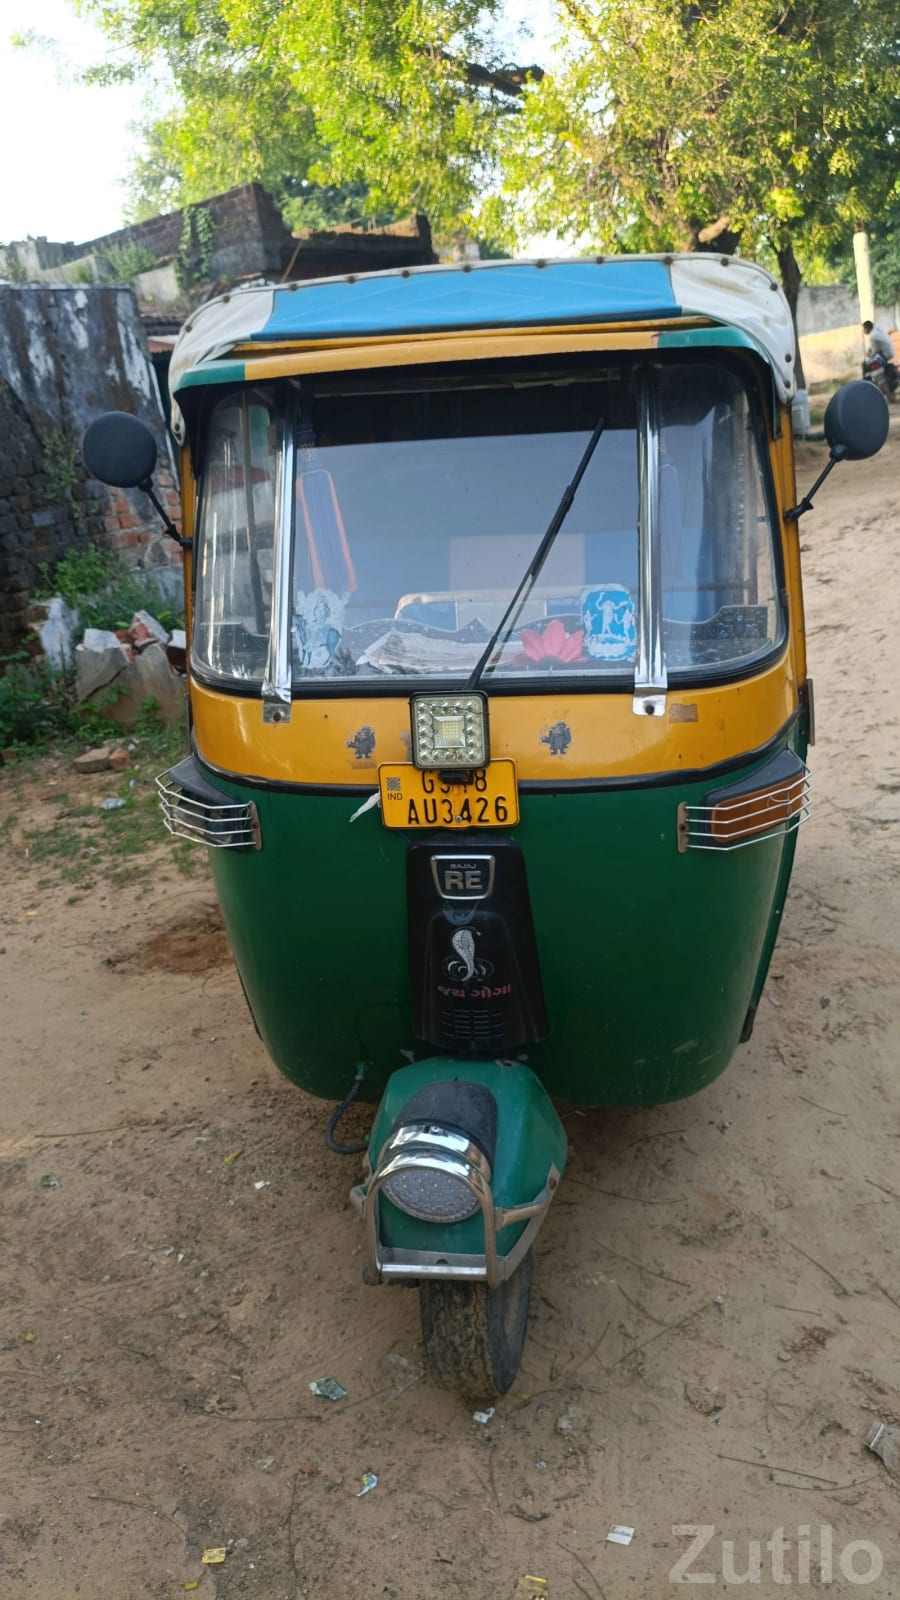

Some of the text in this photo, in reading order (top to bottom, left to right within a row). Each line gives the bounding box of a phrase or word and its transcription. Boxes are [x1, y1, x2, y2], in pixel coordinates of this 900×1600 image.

[387, 793, 403, 801] IND
[408, 796, 508, 824] AU3426
[444, 870, 483, 890] RE
